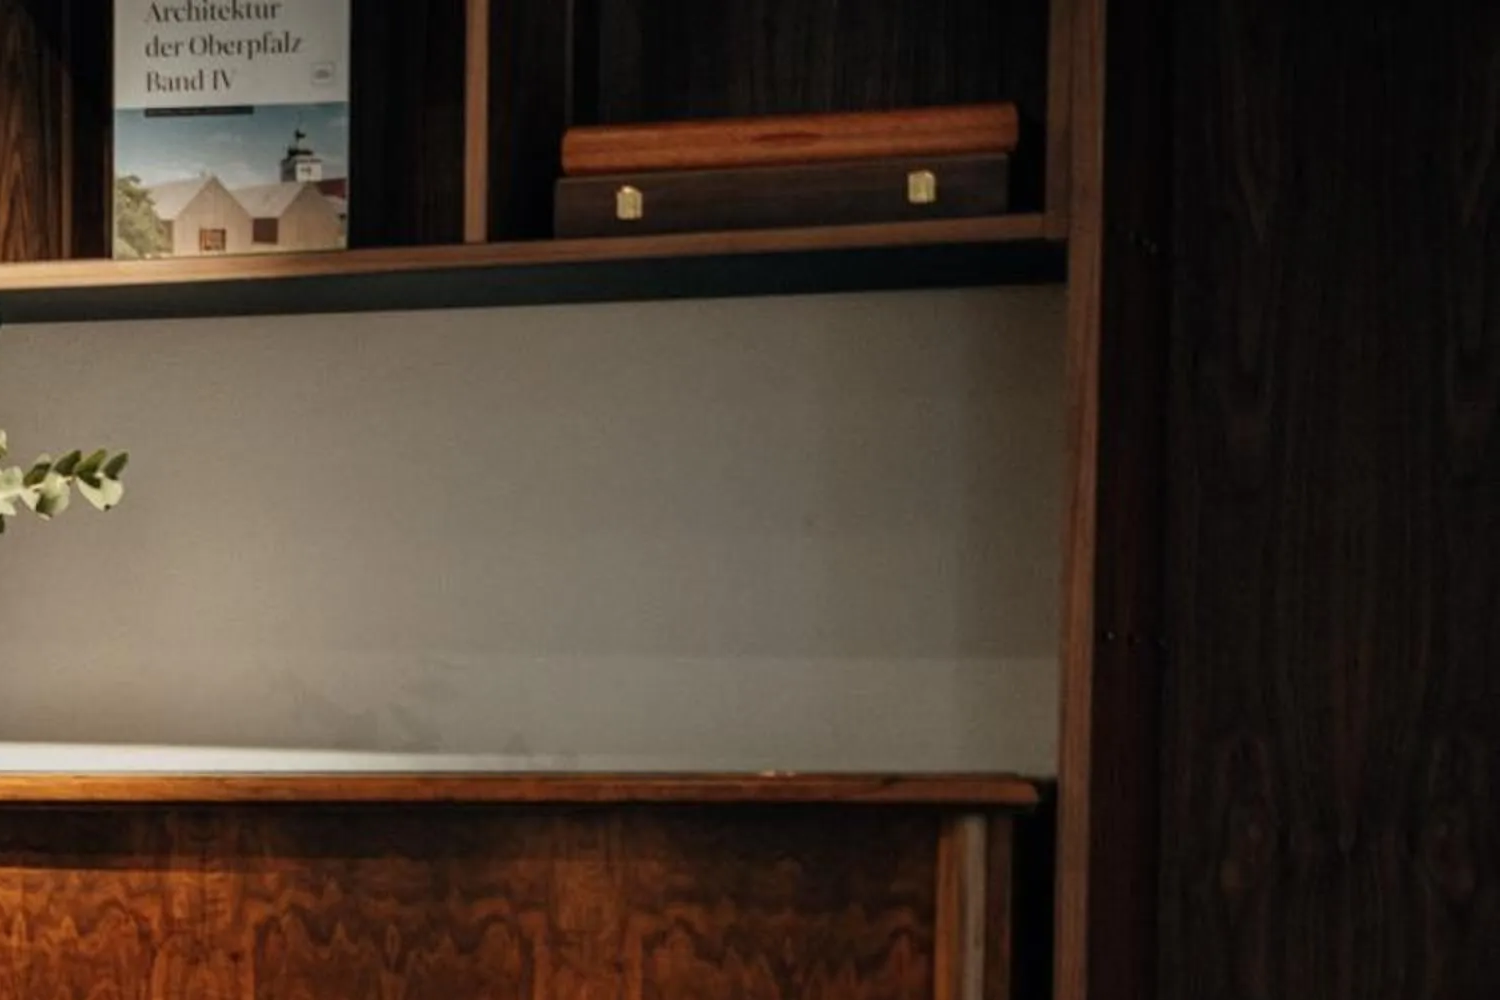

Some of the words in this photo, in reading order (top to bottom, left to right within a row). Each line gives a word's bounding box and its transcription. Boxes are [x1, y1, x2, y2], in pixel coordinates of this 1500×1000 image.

[145, 0, 282, 22] Architektur
[145, 35, 184, 57] der
[189, 31, 303, 60] Oberpfalz
[146, 69, 204, 92] Band
[213, 69, 235, 90] IV
